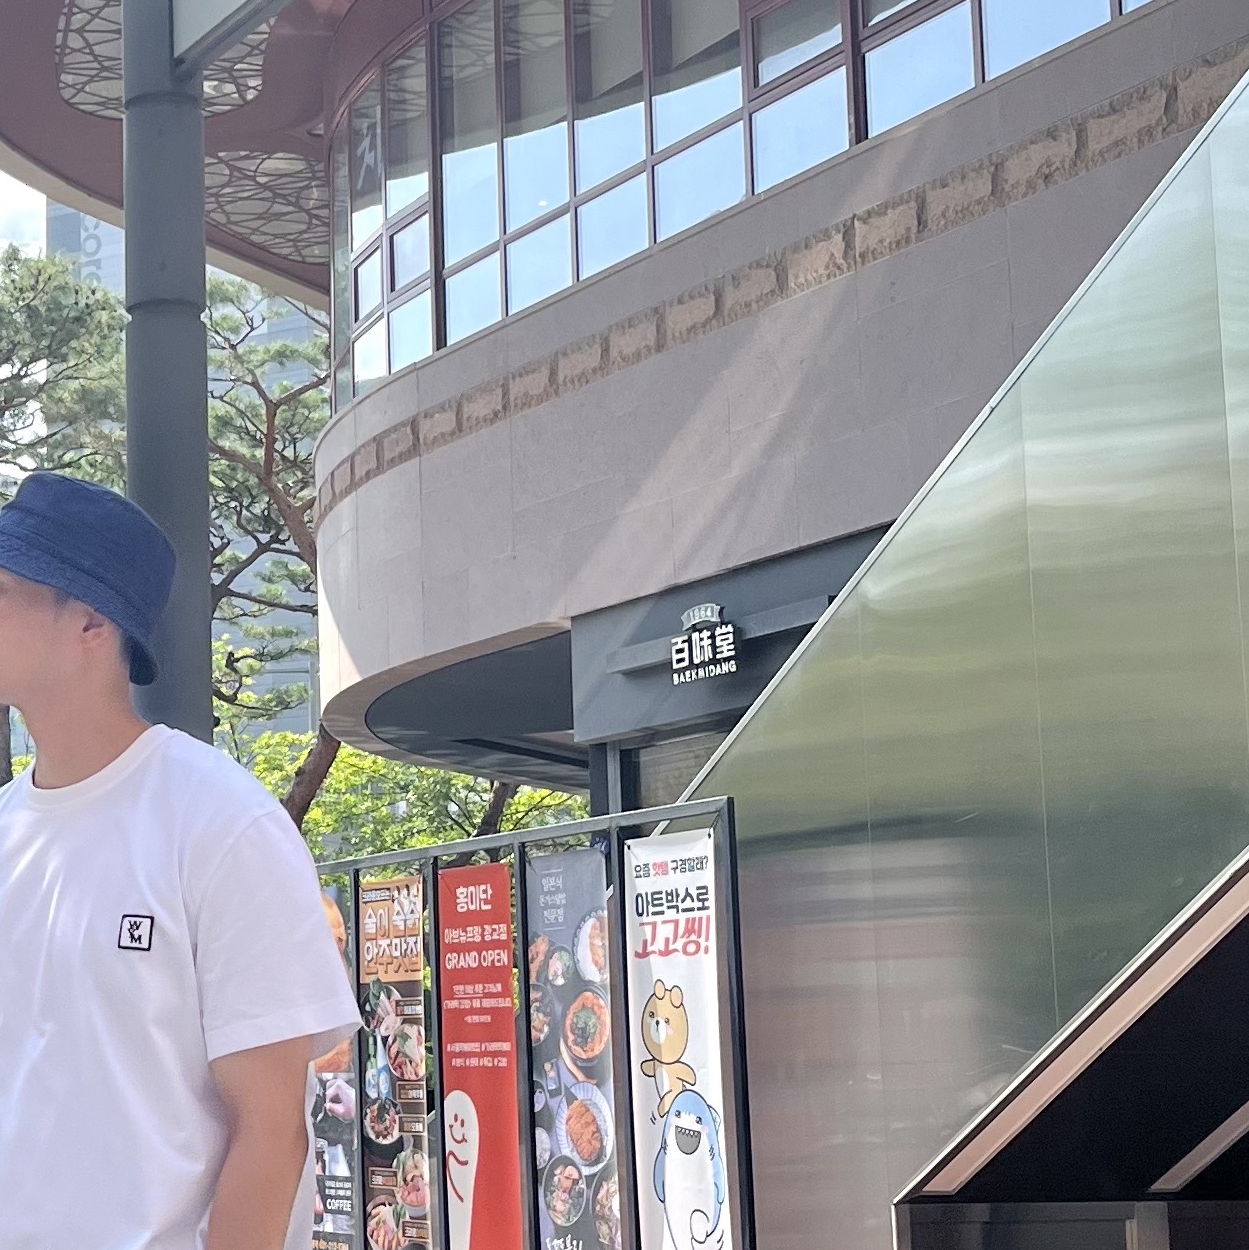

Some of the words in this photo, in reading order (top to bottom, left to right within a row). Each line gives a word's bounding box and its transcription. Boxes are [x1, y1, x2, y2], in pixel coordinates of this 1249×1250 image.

[689, 608, 712, 622] 1964
[670, 624, 737, 670] 百味堂
[672, 660, 737, 686] BAEKMIDANG
[634, 863, 650, 879] 요즘
[652, 861, 669, 877] 핫템
[670, 855, 709, 875] 구경할래?
[455, 883, 493, 913] 홍미단
[635, 885, 710, 917] 아트박스로
[543, 907, 564, 924] 전문점
[444, 926, 482, 944] 아브뉴프랑
[483, 923, 508, 942] 광교점
[634, 914, 711, 959] 고고씽!
[445, 951, 479, 970] GRAND
[480, 948, 509, 968] OPEN
[326, 1198, 352, 1212] COFFEE
